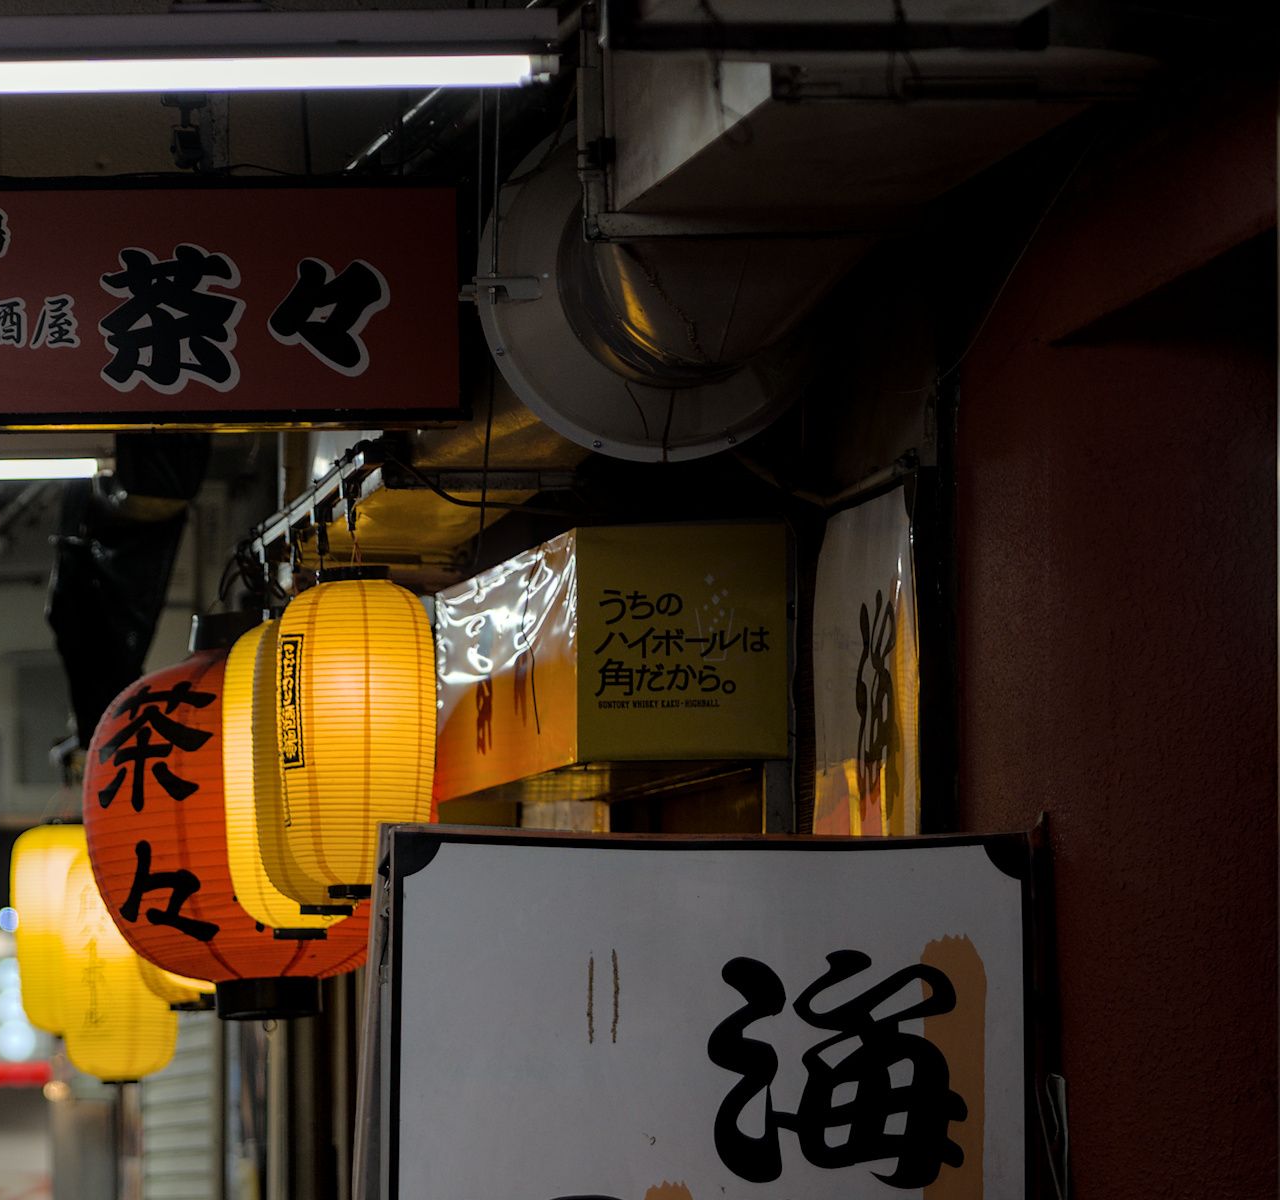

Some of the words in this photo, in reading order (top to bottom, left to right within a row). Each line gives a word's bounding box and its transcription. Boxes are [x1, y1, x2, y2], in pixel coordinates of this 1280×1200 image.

[101, 246, 392, 392] 茶々
[599, 589, 683, 625] うちの
[594, 626, 770, 659] ハイボールは
[595, 658, 737, 697] 角だから。
[97, 679, 221, 942] 茶々
